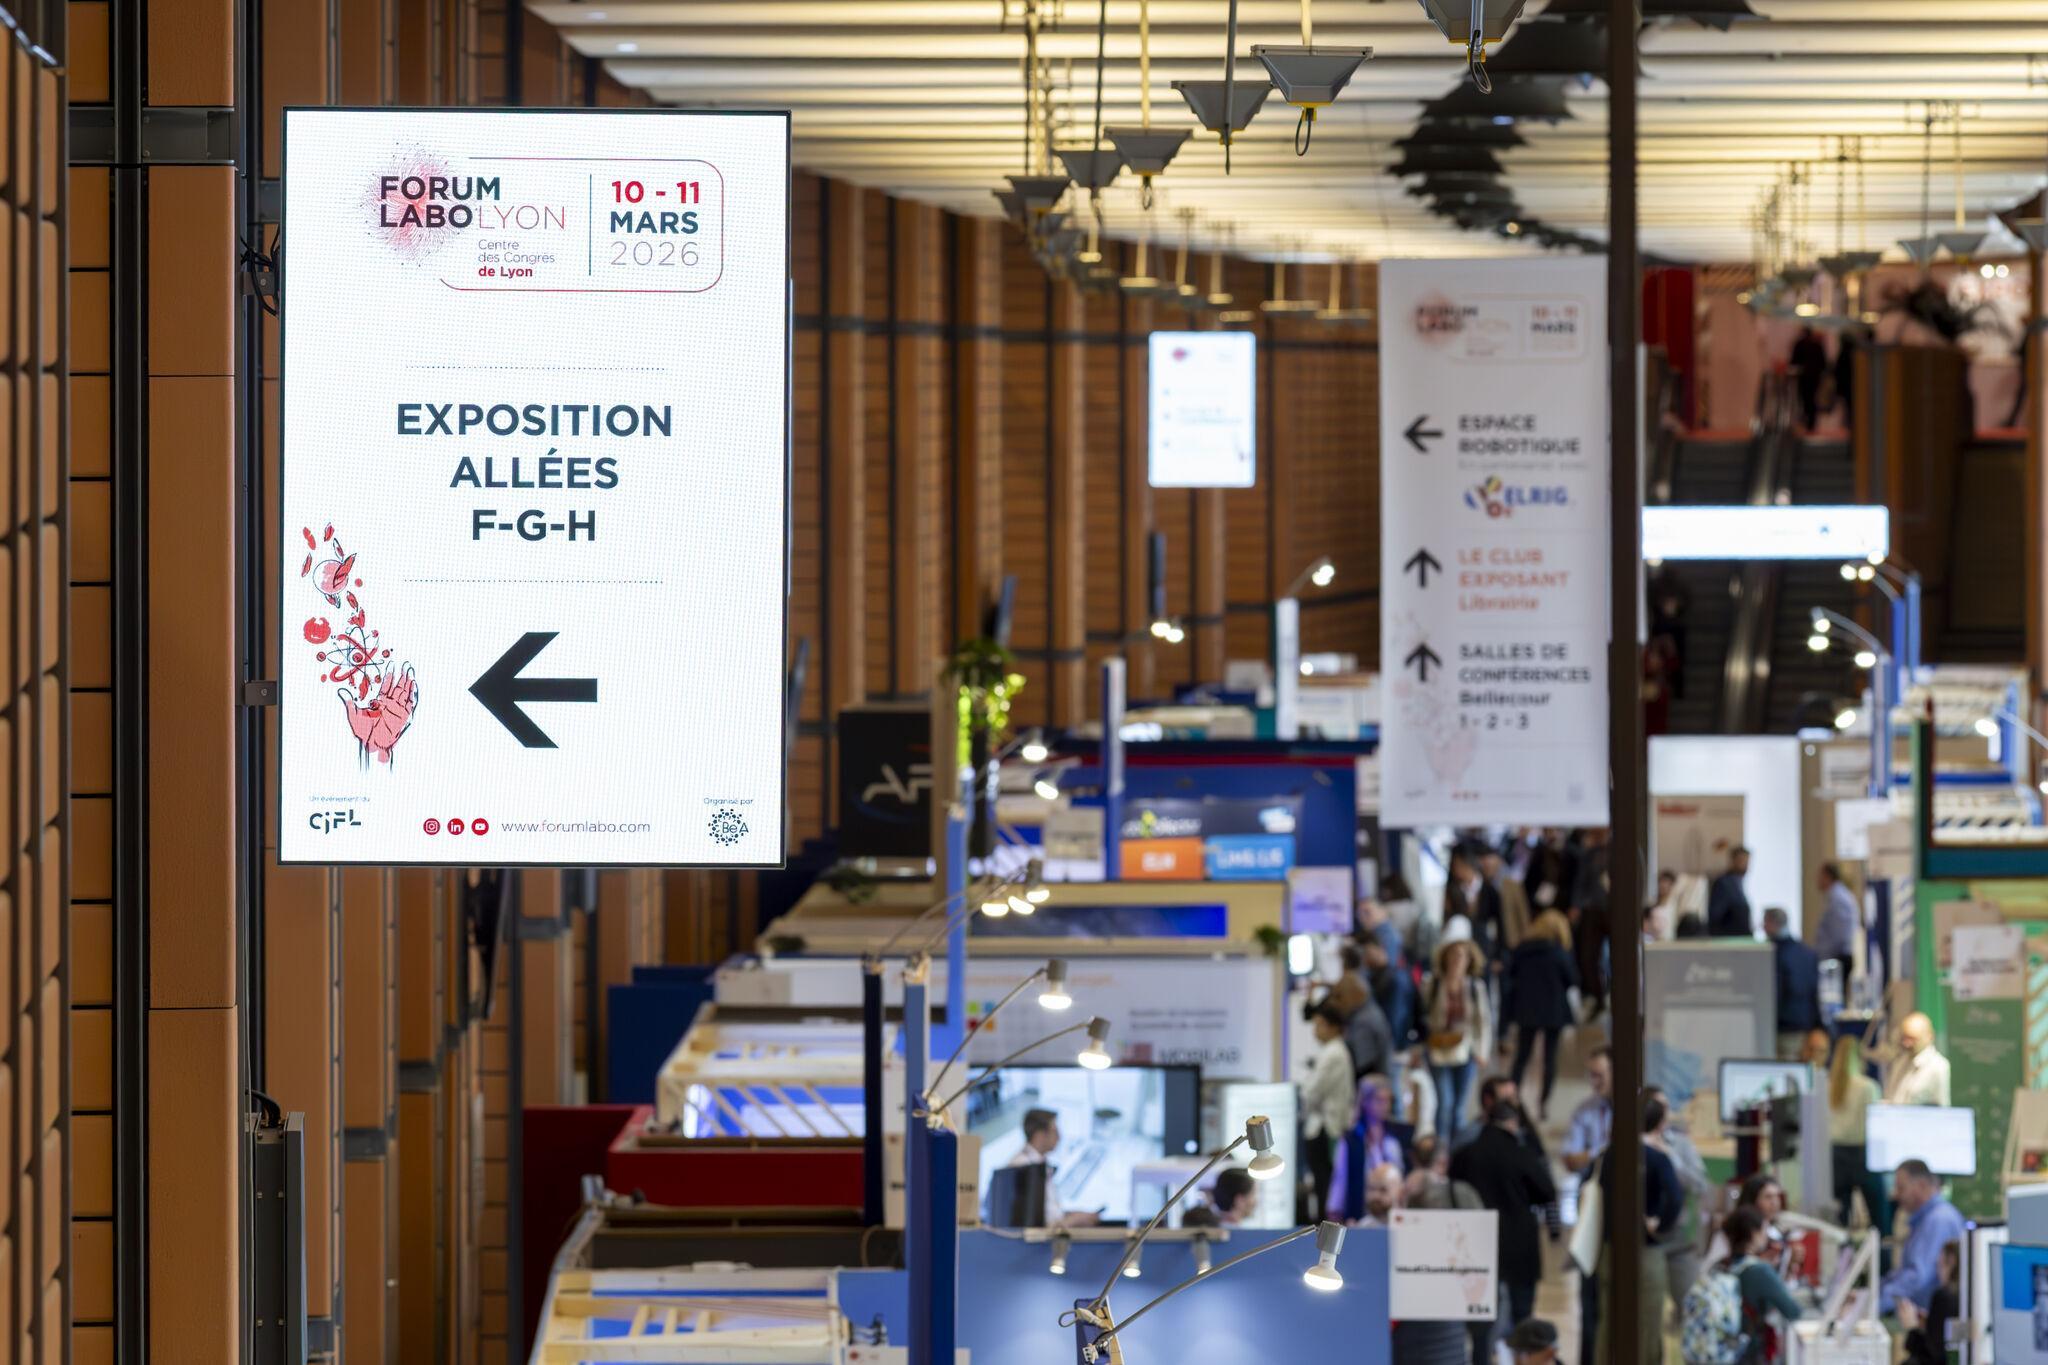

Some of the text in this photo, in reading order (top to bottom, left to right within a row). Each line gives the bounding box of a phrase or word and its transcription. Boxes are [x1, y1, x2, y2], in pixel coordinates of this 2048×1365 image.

[380, 175, 501, 201] FORUM
[611, 180, 645, 204] 10
[676, 181, 700, 204] 11
[379, 204, 566, 231] LABO LYON
[610, 211, 699, 235] MARS
[478, 239, 519, 250] Centre
[610, 241, 700, 267] 2026
[478, 252, 500, 262] des
[478, 265, 533, 279] de Lyon
[397, 403, 672, 437] EXPOSITION
[1458, 415, 1536, 432] ESPACE
[1458, 437, 1581, 454] ROBOTIQUE
[449, 447, 619, 489] ALLÉES
[472, 509, 596, 541] F-G-H
[1458, 548, 1542, 564] LE CLUB
[1459, 571, 1569, 588] EXPOSANT
[1459, 642, 1568, 661] SALLES DE
[501, 820, 651, 833] www.forumlabo.com
